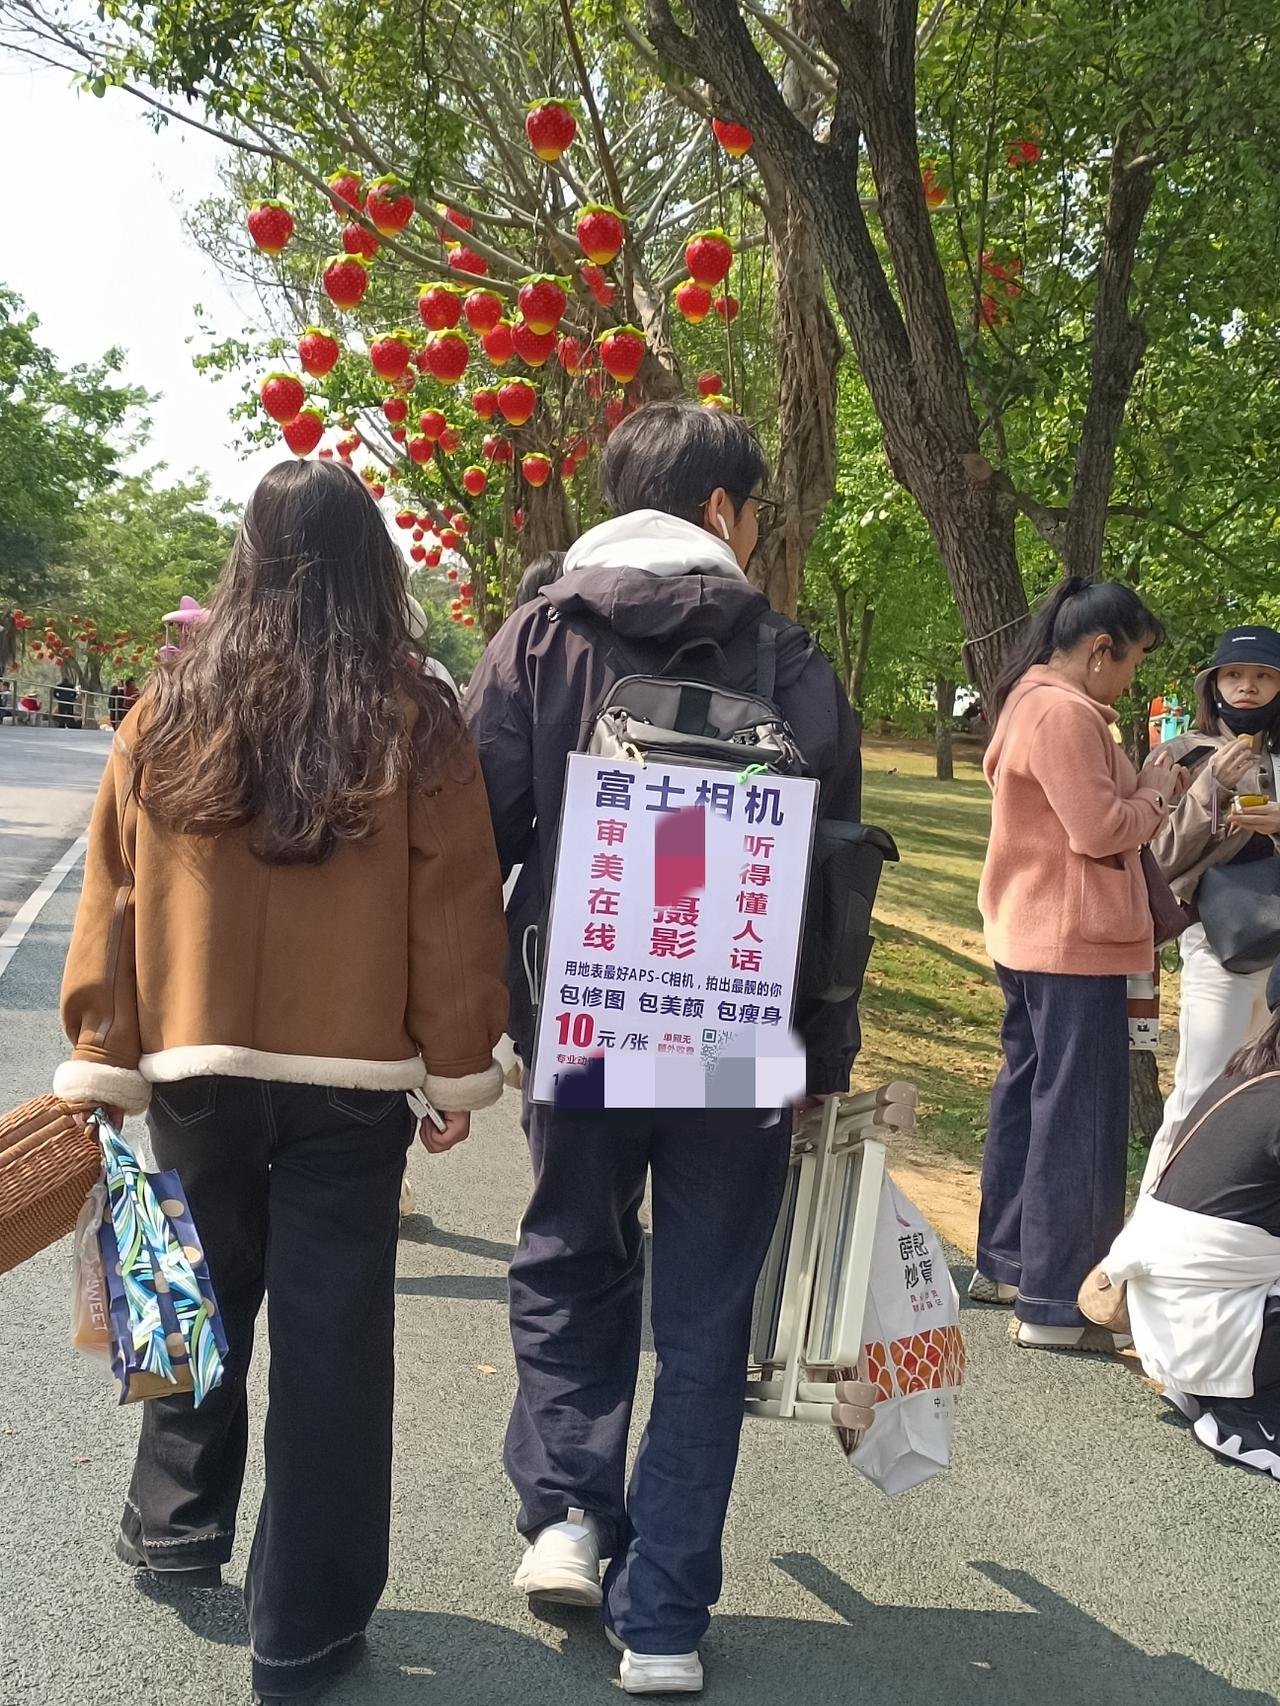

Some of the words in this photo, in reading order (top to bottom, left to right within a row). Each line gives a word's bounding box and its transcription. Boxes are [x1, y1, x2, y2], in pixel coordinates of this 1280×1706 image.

[595, 769, 785, 827] 富士相机
[582, 818, 628, 952] 审美在线
[729, 834, 775, 973] 听得懂人话
[559, 983, 626, 1011] 包修图
[638, 991, 705, 1019] 包美颜
[716, 1000, 783, 1026] 包瘦身
